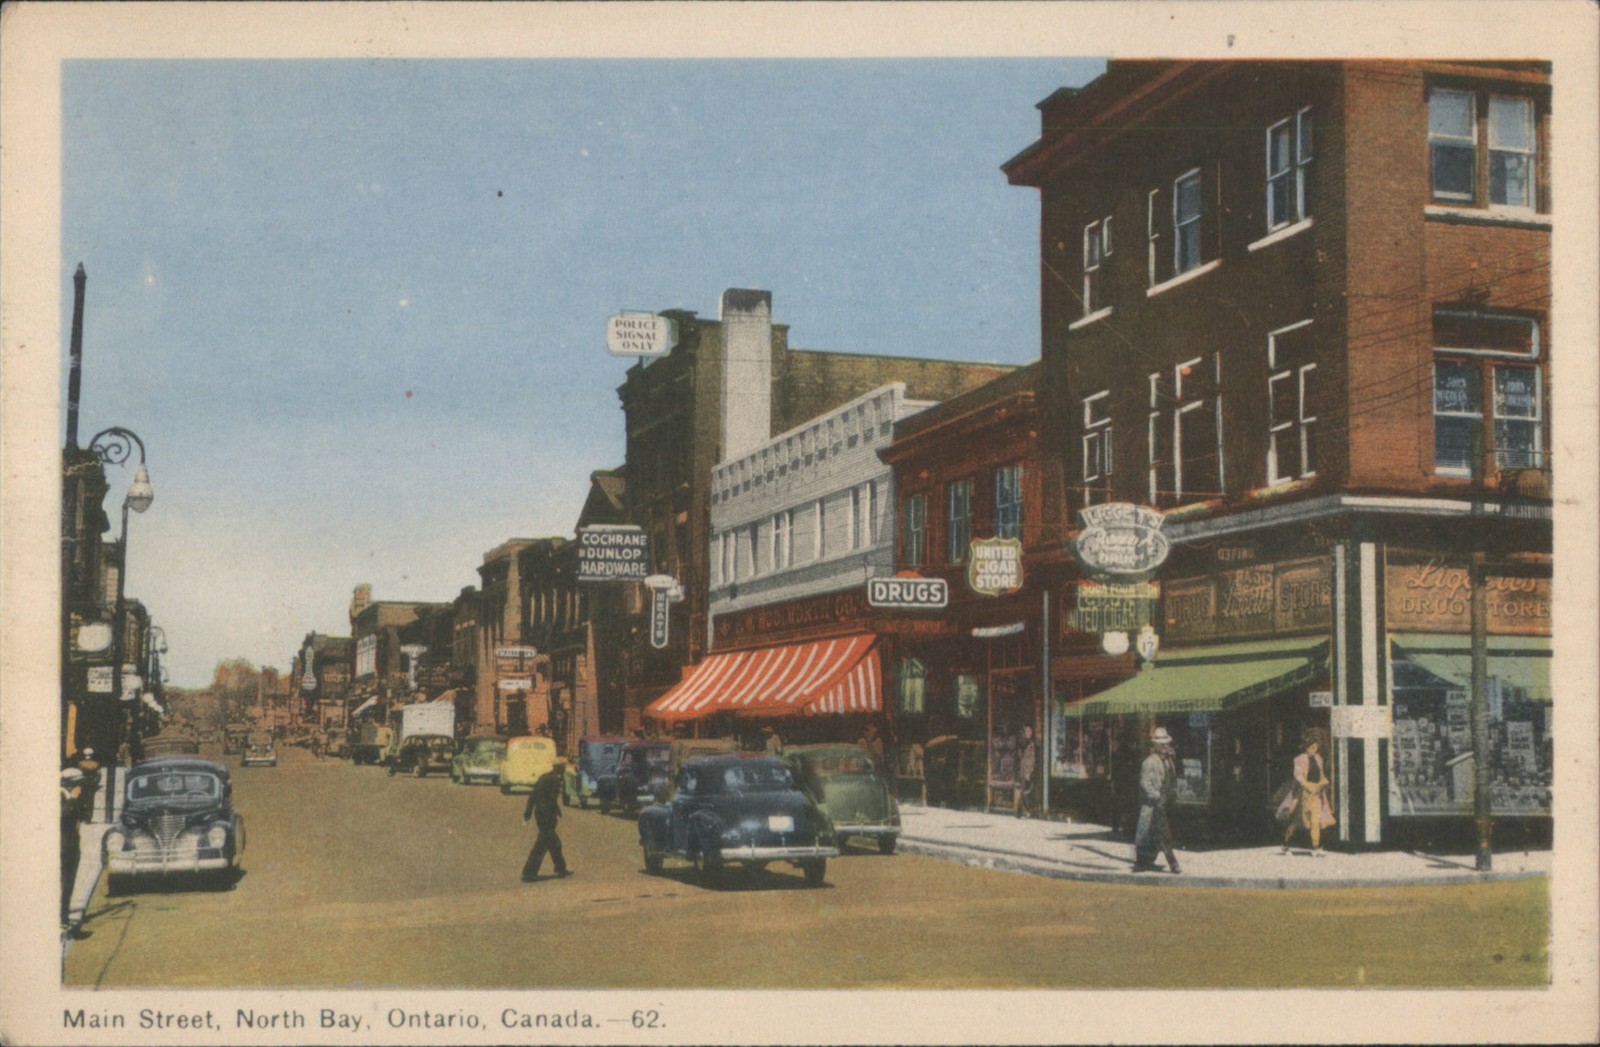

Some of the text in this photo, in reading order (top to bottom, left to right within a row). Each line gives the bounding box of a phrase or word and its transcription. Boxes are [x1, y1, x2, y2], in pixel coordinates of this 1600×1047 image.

[615, 319, 657, 330] POLICE
[616, 330, 656, 340] SIGNAL
[622, 341, 653, 350] ONLY
[582, 533, 648, 546] COCHRANE
[587, 547, 642, 559] DUNLOP
[976, 545, 1016, 559] UNITED
[581, 561, 648, 576] HARDWARE
[976, 560, 1017, 574] CIGAR
[976, 574, 1017, 589] STORE
[874, 583, 942, 602] DRUGS
[1402, 599, 1550, 618] DRUG TORE
